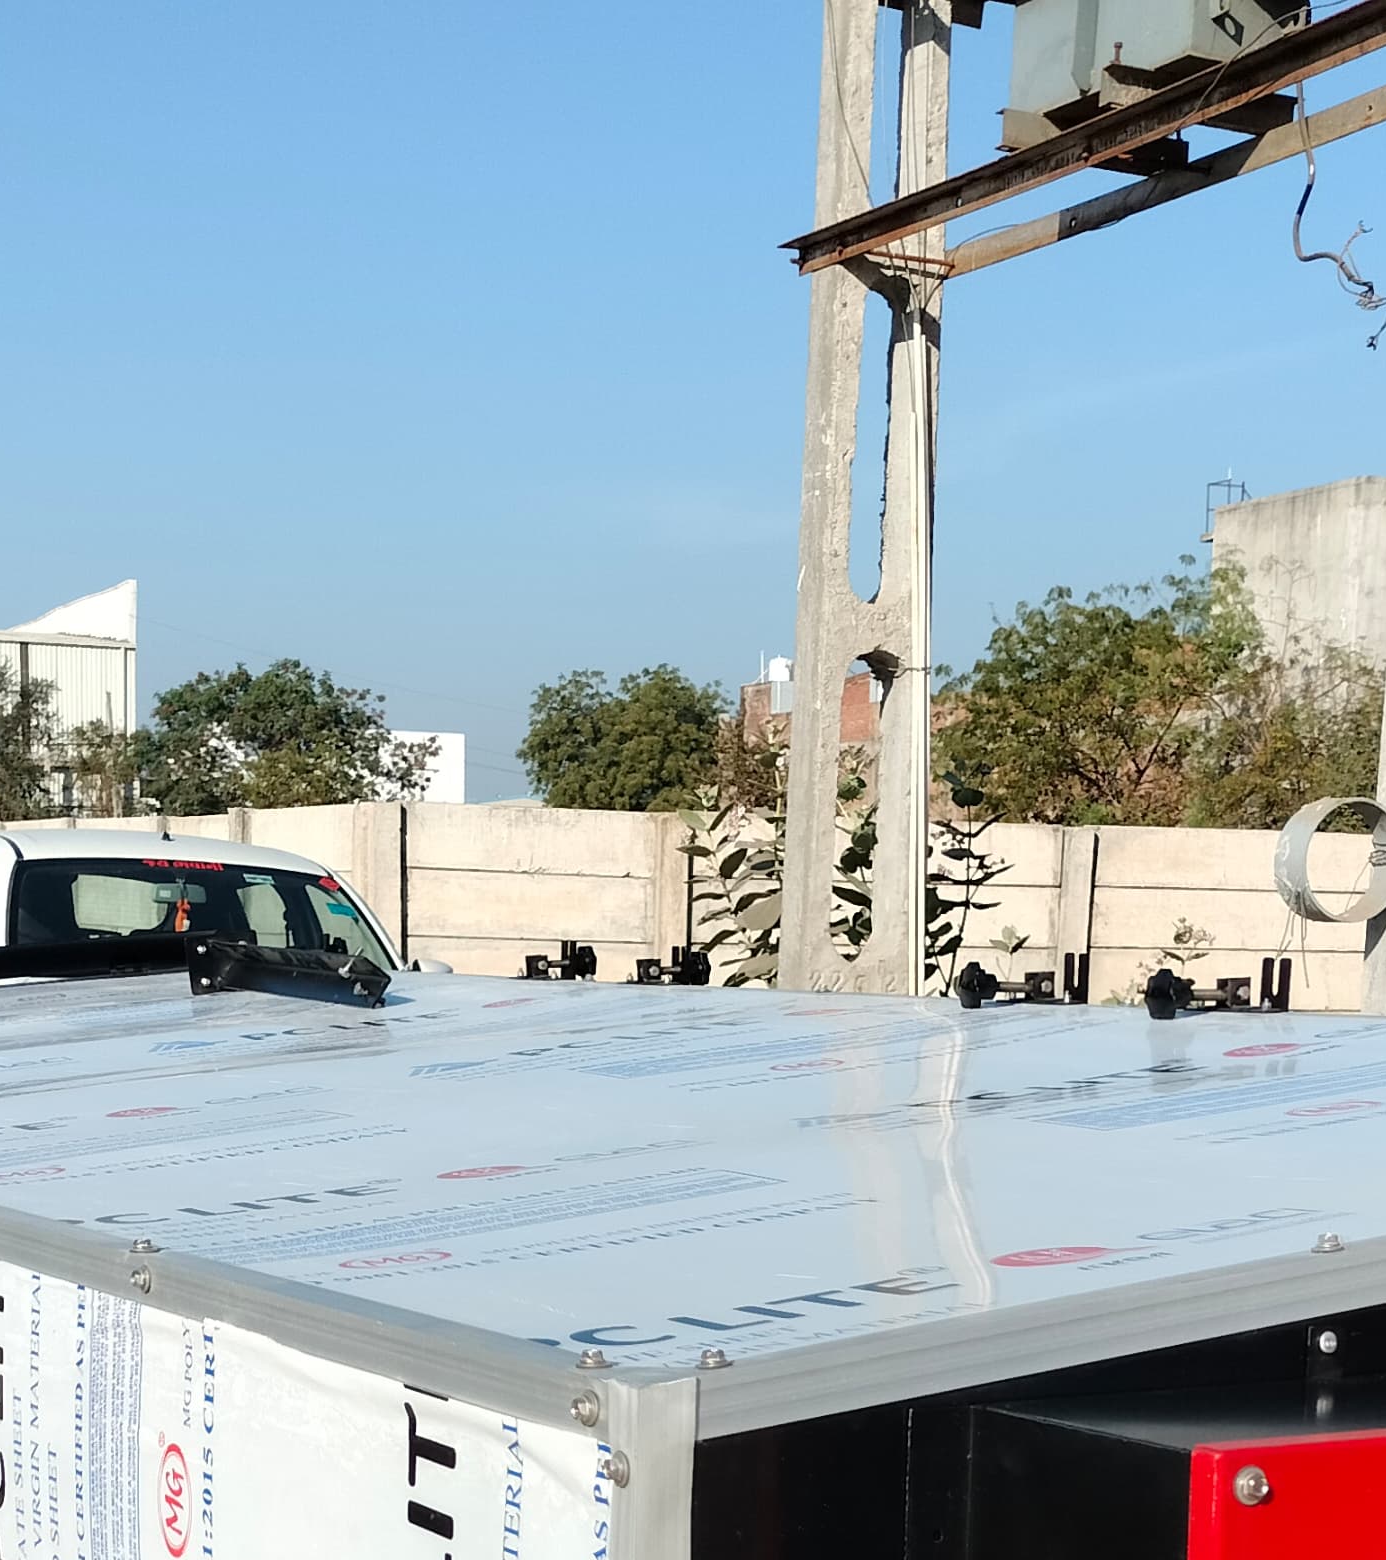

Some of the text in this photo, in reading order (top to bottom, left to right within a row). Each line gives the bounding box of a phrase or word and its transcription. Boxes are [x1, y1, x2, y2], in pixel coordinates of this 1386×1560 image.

[328, 1012, 458, 1030] LITE
[175, 1185, 398, 1216] LITE
[666, 1277, 961, 1331] LITE
[75, 1338, 86, 1377] AS
[11, 1387, 25, 1490] SHEET
[74, 1381, 86, 1543] CERTIFIED
[29, 1428, 44, 1550] VIRGIN
[47, 1442, 62, 1546] SHEET
